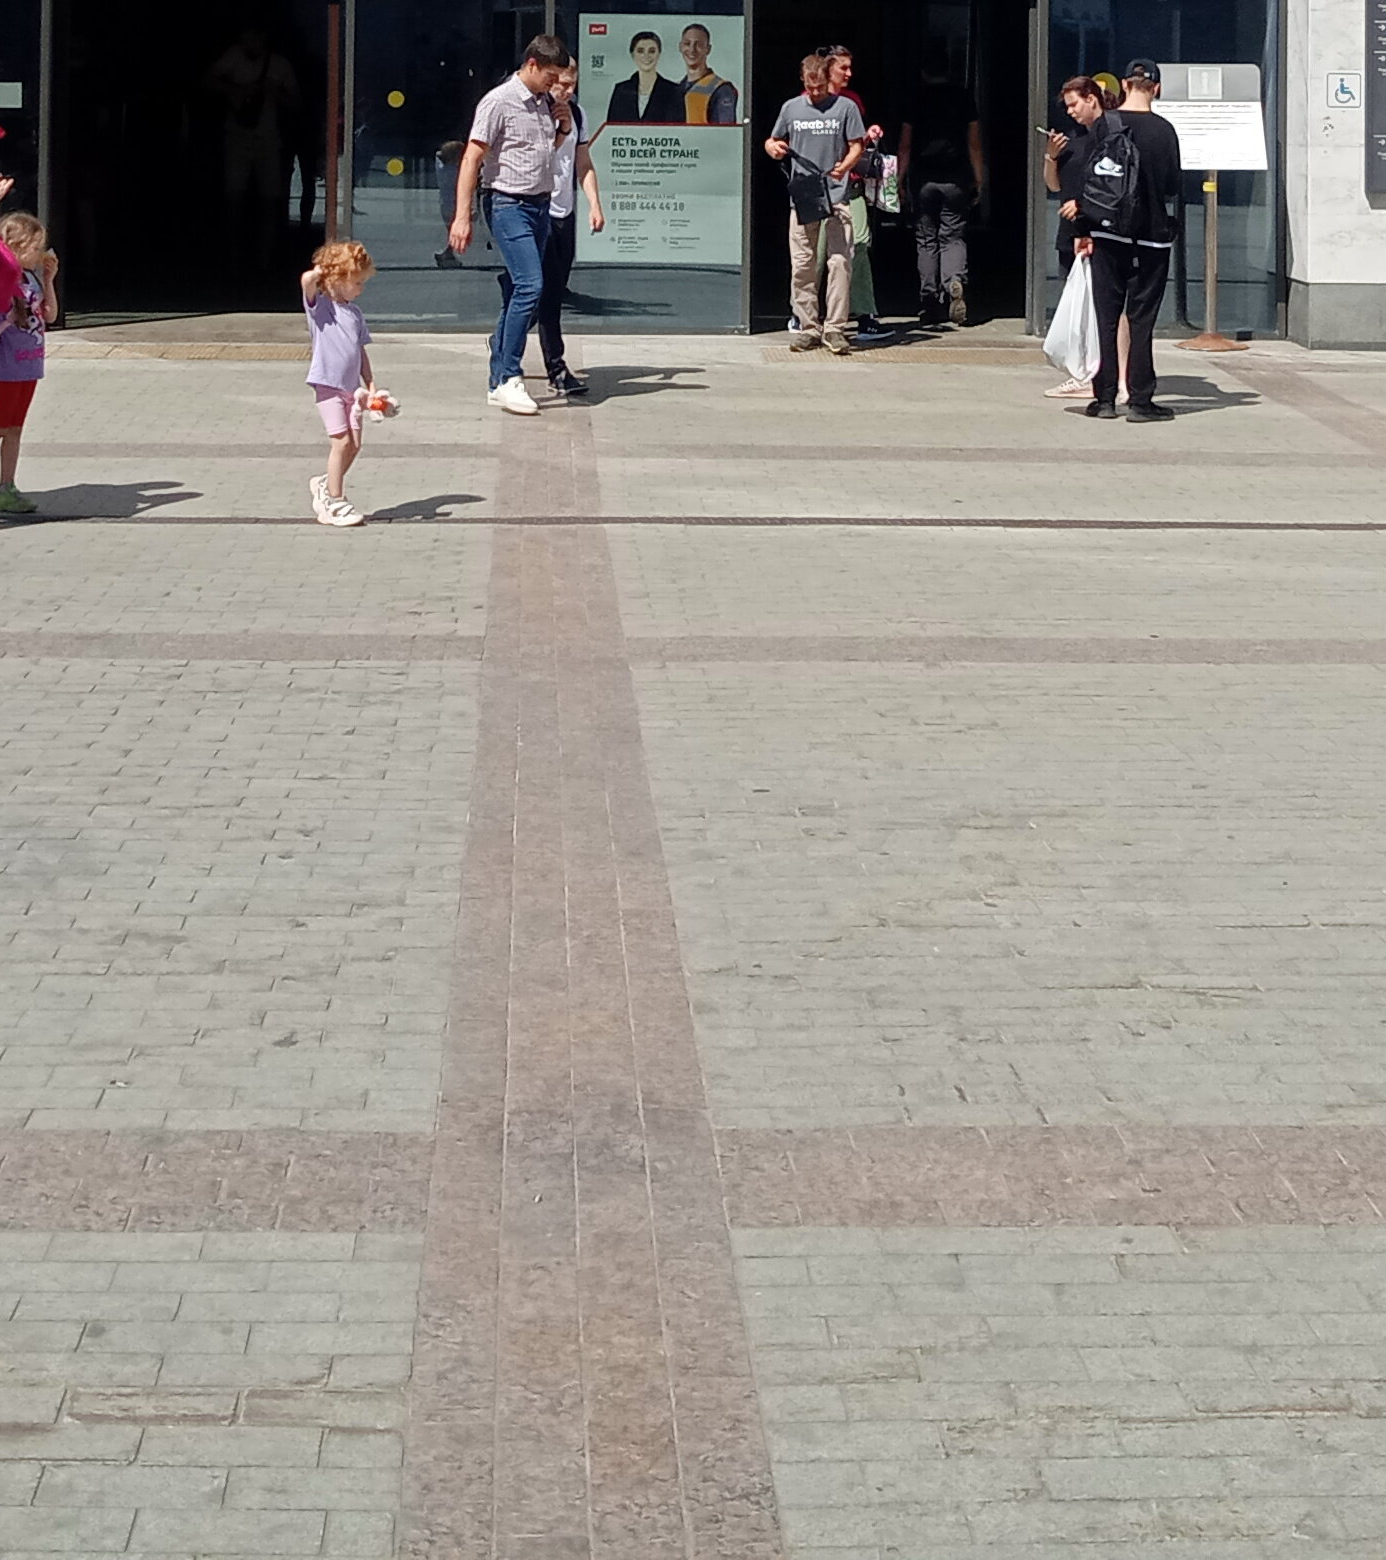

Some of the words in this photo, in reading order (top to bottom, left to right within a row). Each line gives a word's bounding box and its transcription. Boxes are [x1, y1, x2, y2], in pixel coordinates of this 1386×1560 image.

[611, 137, 638, 147] ЕСТЬ
[640, 137, 681, 147] РАБОТА
[611, 148, 627, 159] ПО
[630, 147, 657, 159] ВСЕЙ
[659, 149, 700, 160] СТРАНЕ
